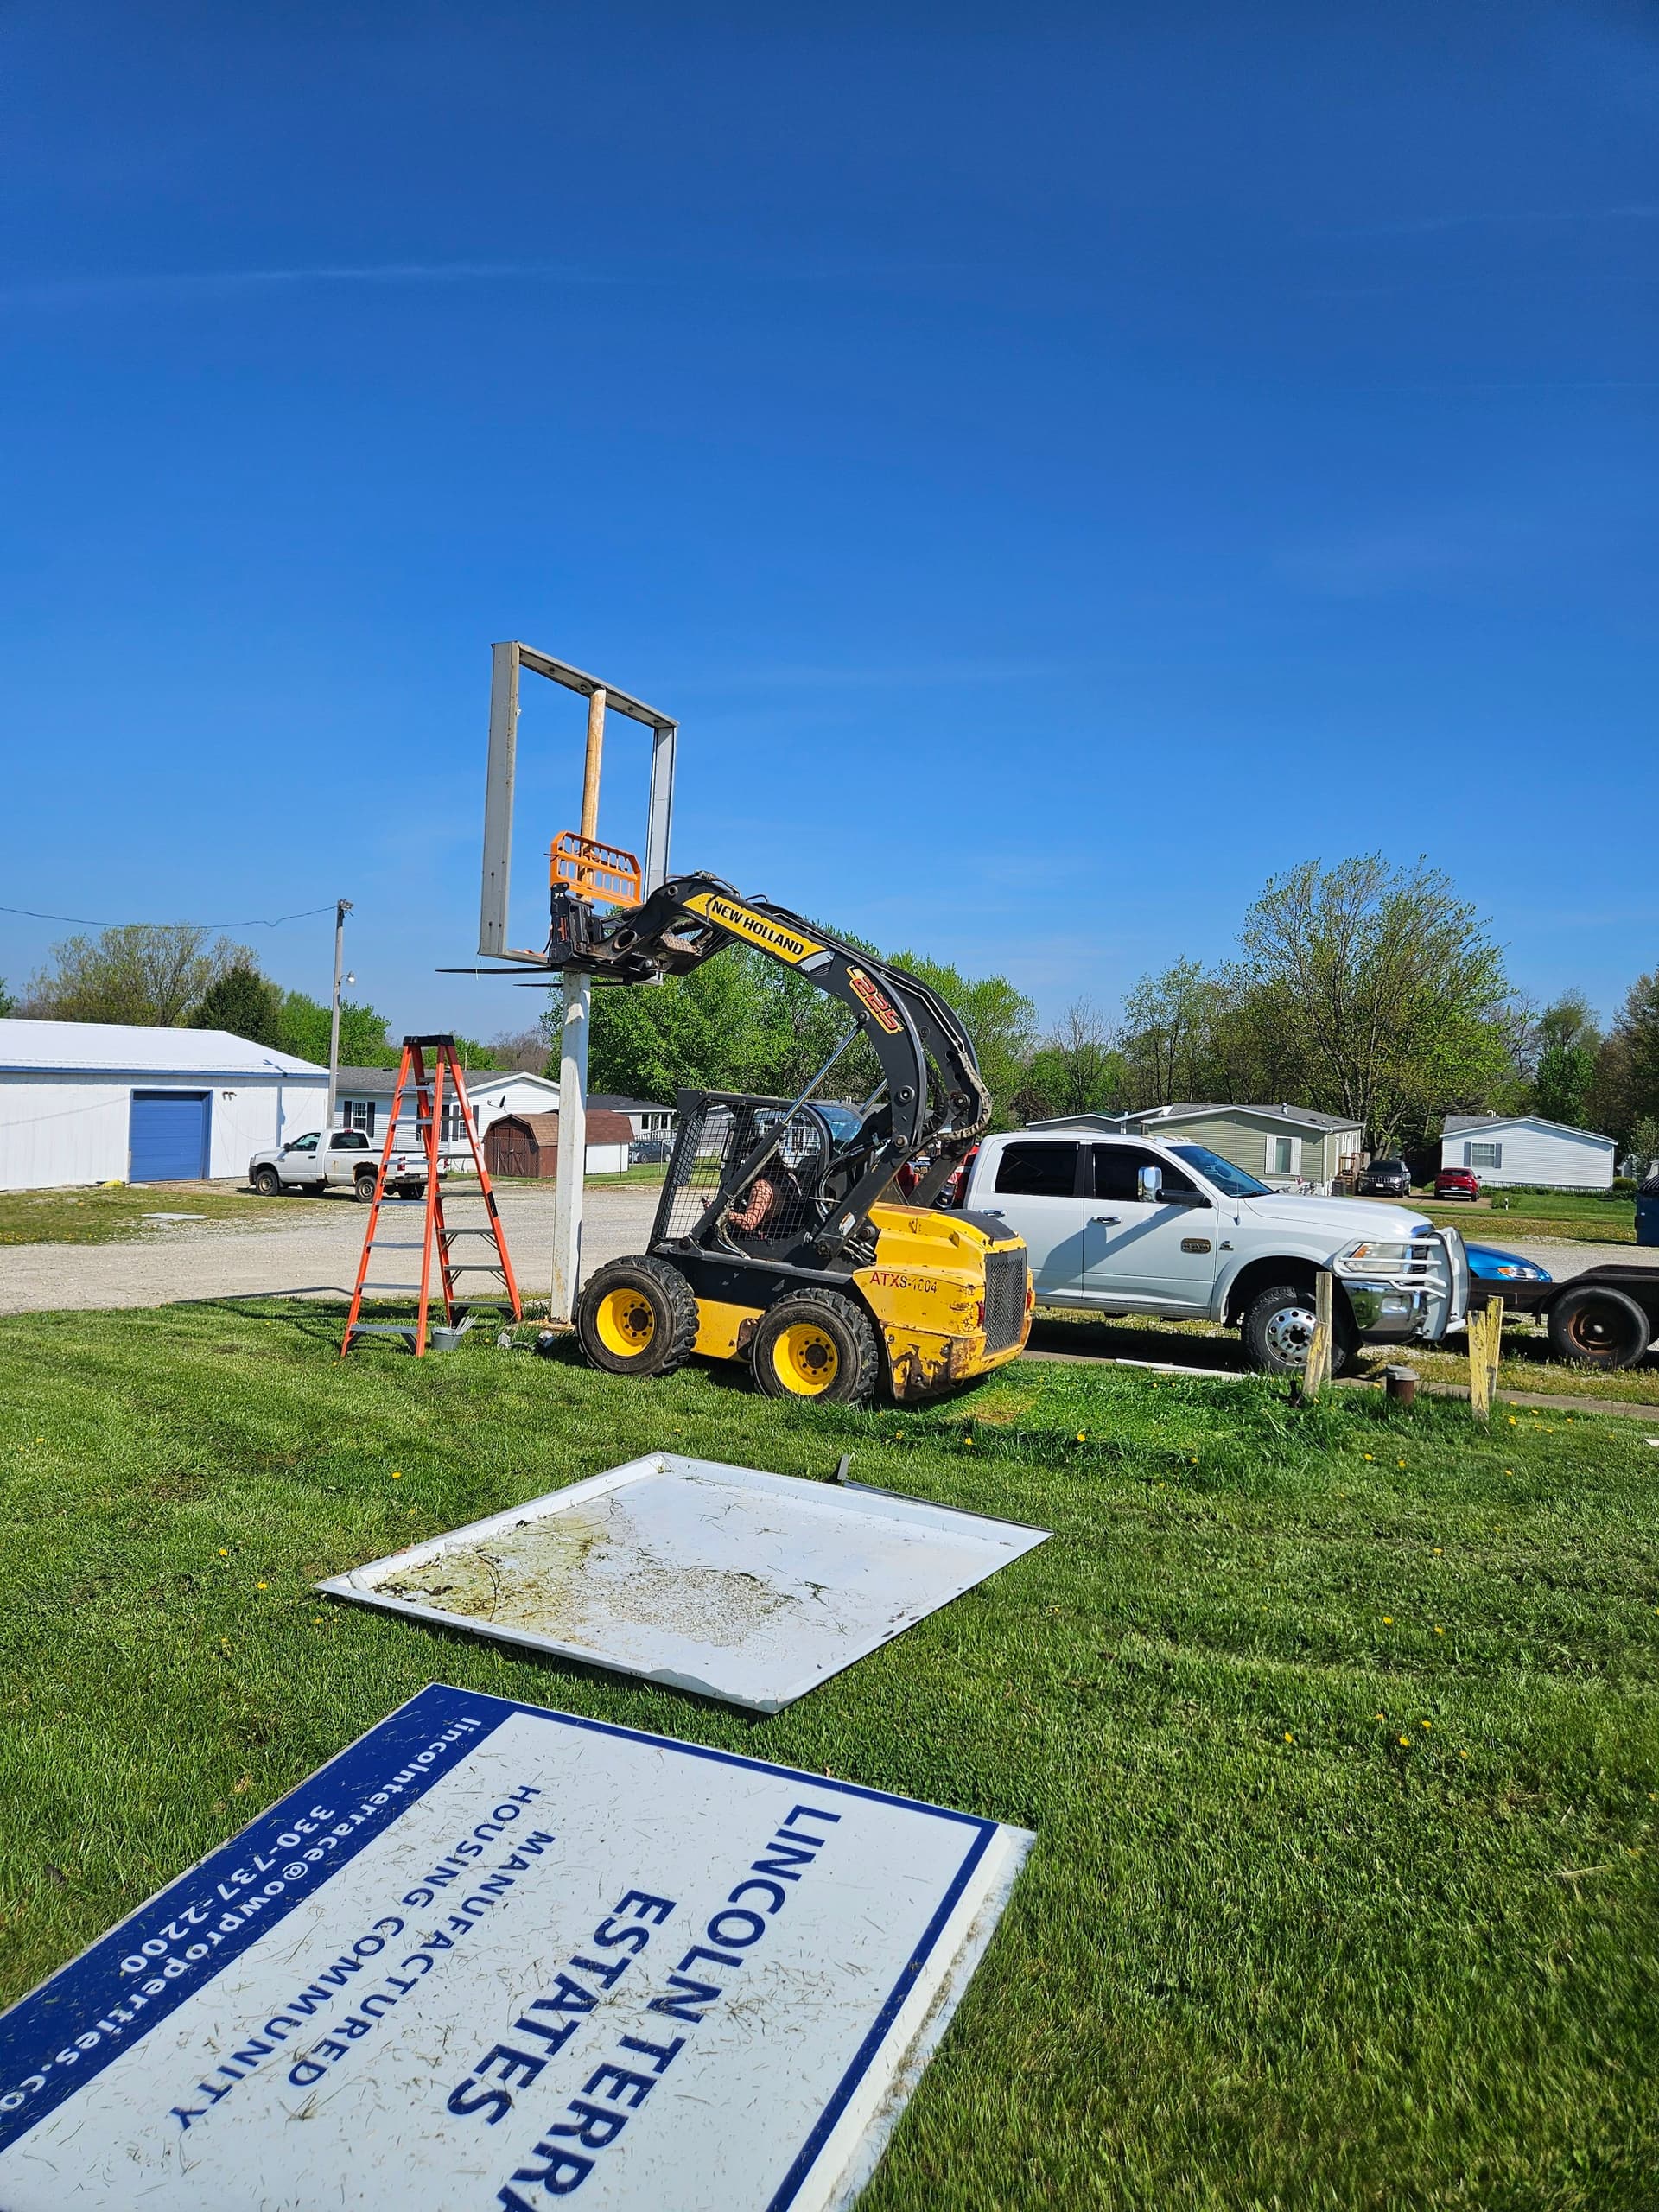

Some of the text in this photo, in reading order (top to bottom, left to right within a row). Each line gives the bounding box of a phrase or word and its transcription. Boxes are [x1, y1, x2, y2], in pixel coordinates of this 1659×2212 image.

[711, 900, 804, 956] NEW HOLLAND
[120, 1804, 335, 1974] 330-737-2200
[170, 1784, 541, 2131] HOUSING COMMUNITY
[288, 1830, 556, 2087] MANUFACTURED
[645, 1804, 842, 2024] LINCOLN
[447, 1889, 677, 2126] ESTATES
